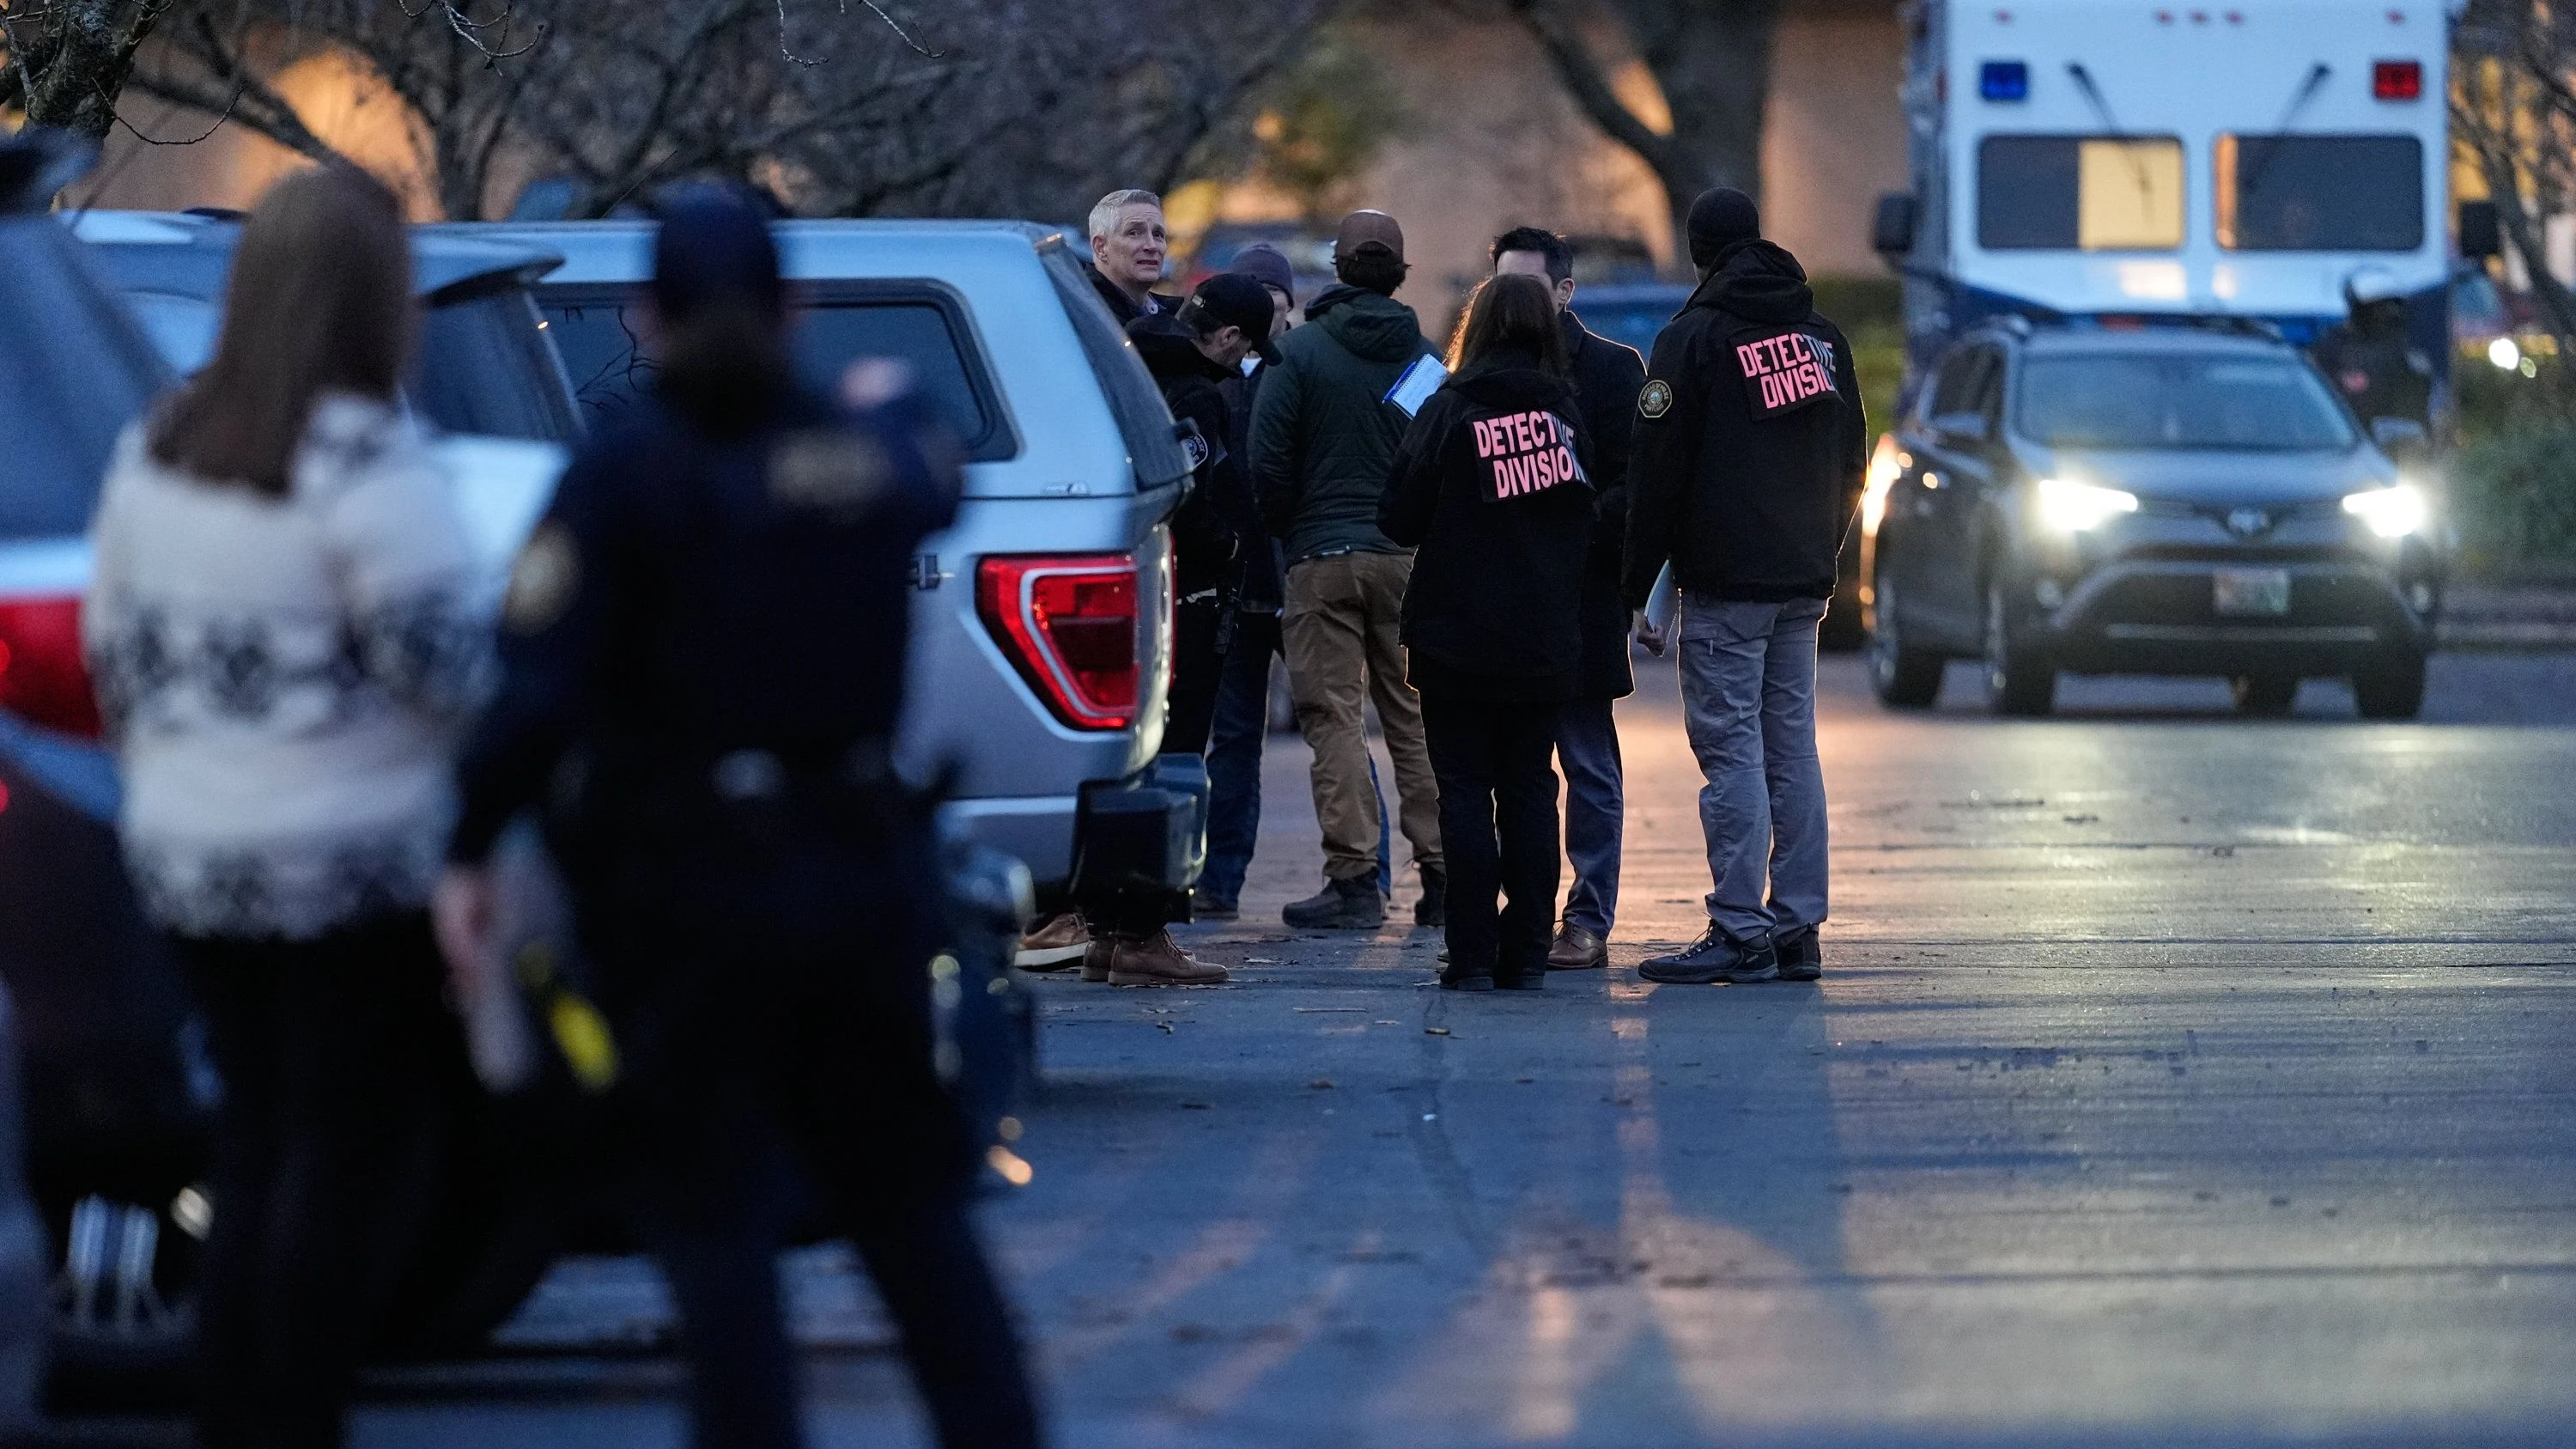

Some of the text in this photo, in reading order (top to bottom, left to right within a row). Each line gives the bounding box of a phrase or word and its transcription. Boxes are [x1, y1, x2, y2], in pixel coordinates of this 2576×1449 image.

[1736, 332, 1837, 378] DETECTIVE
[1759, 361, 1836, 409] DIVISIO
[1473, 411, 1575, 458] DETECTIVE
